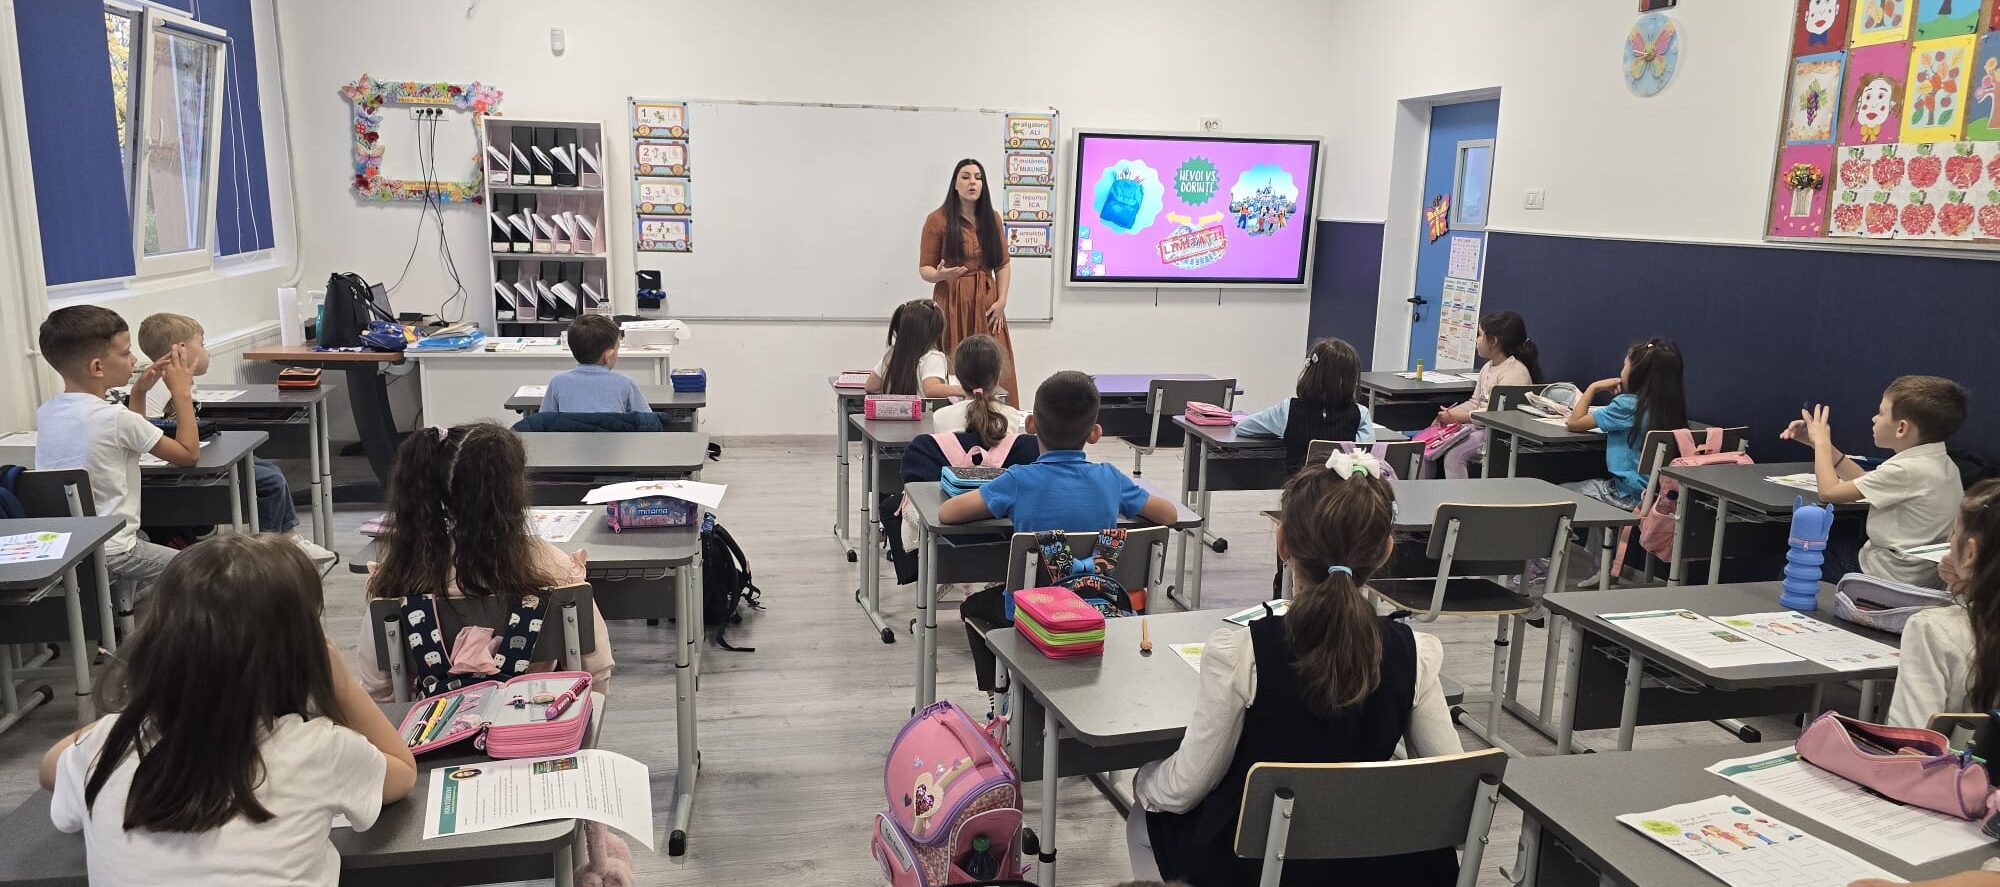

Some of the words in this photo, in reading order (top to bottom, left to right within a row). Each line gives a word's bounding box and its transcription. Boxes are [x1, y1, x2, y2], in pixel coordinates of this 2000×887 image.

[641, 108, 646, 118] 1
[642, 147, 649, 157] 2
[1180, 169, 1204, 181] NEVOI
[644, 186, 651, 195] 3
[645, 223, 652, 233] 4
